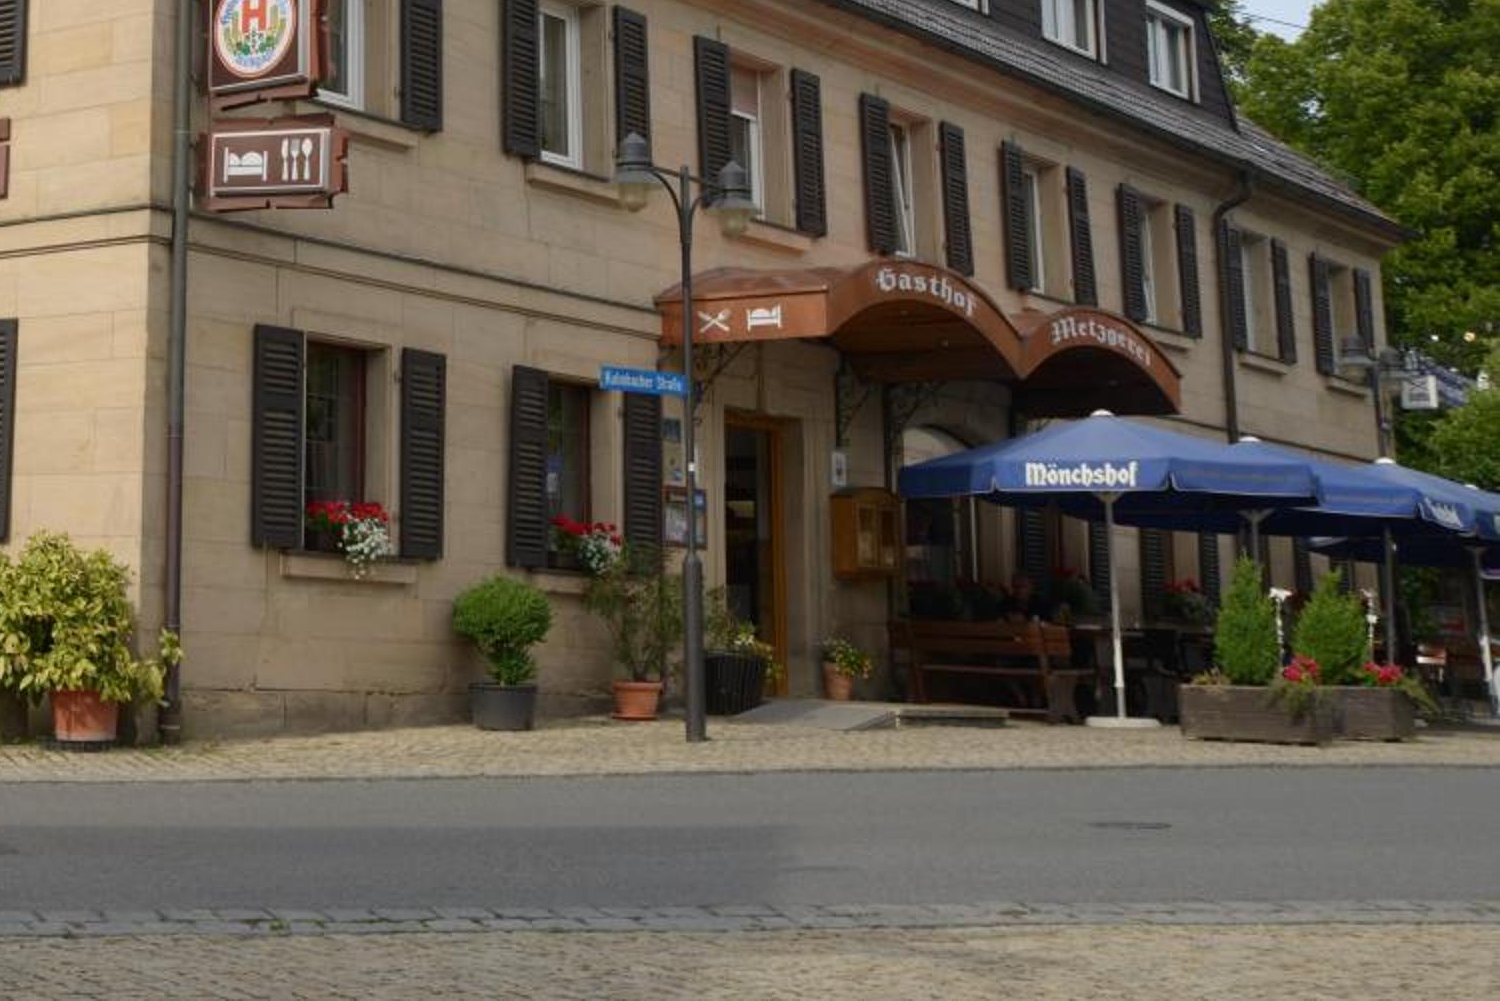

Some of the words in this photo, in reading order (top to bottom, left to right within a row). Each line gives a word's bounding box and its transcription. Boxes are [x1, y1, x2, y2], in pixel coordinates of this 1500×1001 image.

[875, 268, 978, 317] Gasthof
[1051, 316, 1151, 365] Metzgerei
[1025, 460, 1138, 488] Mönchshof
